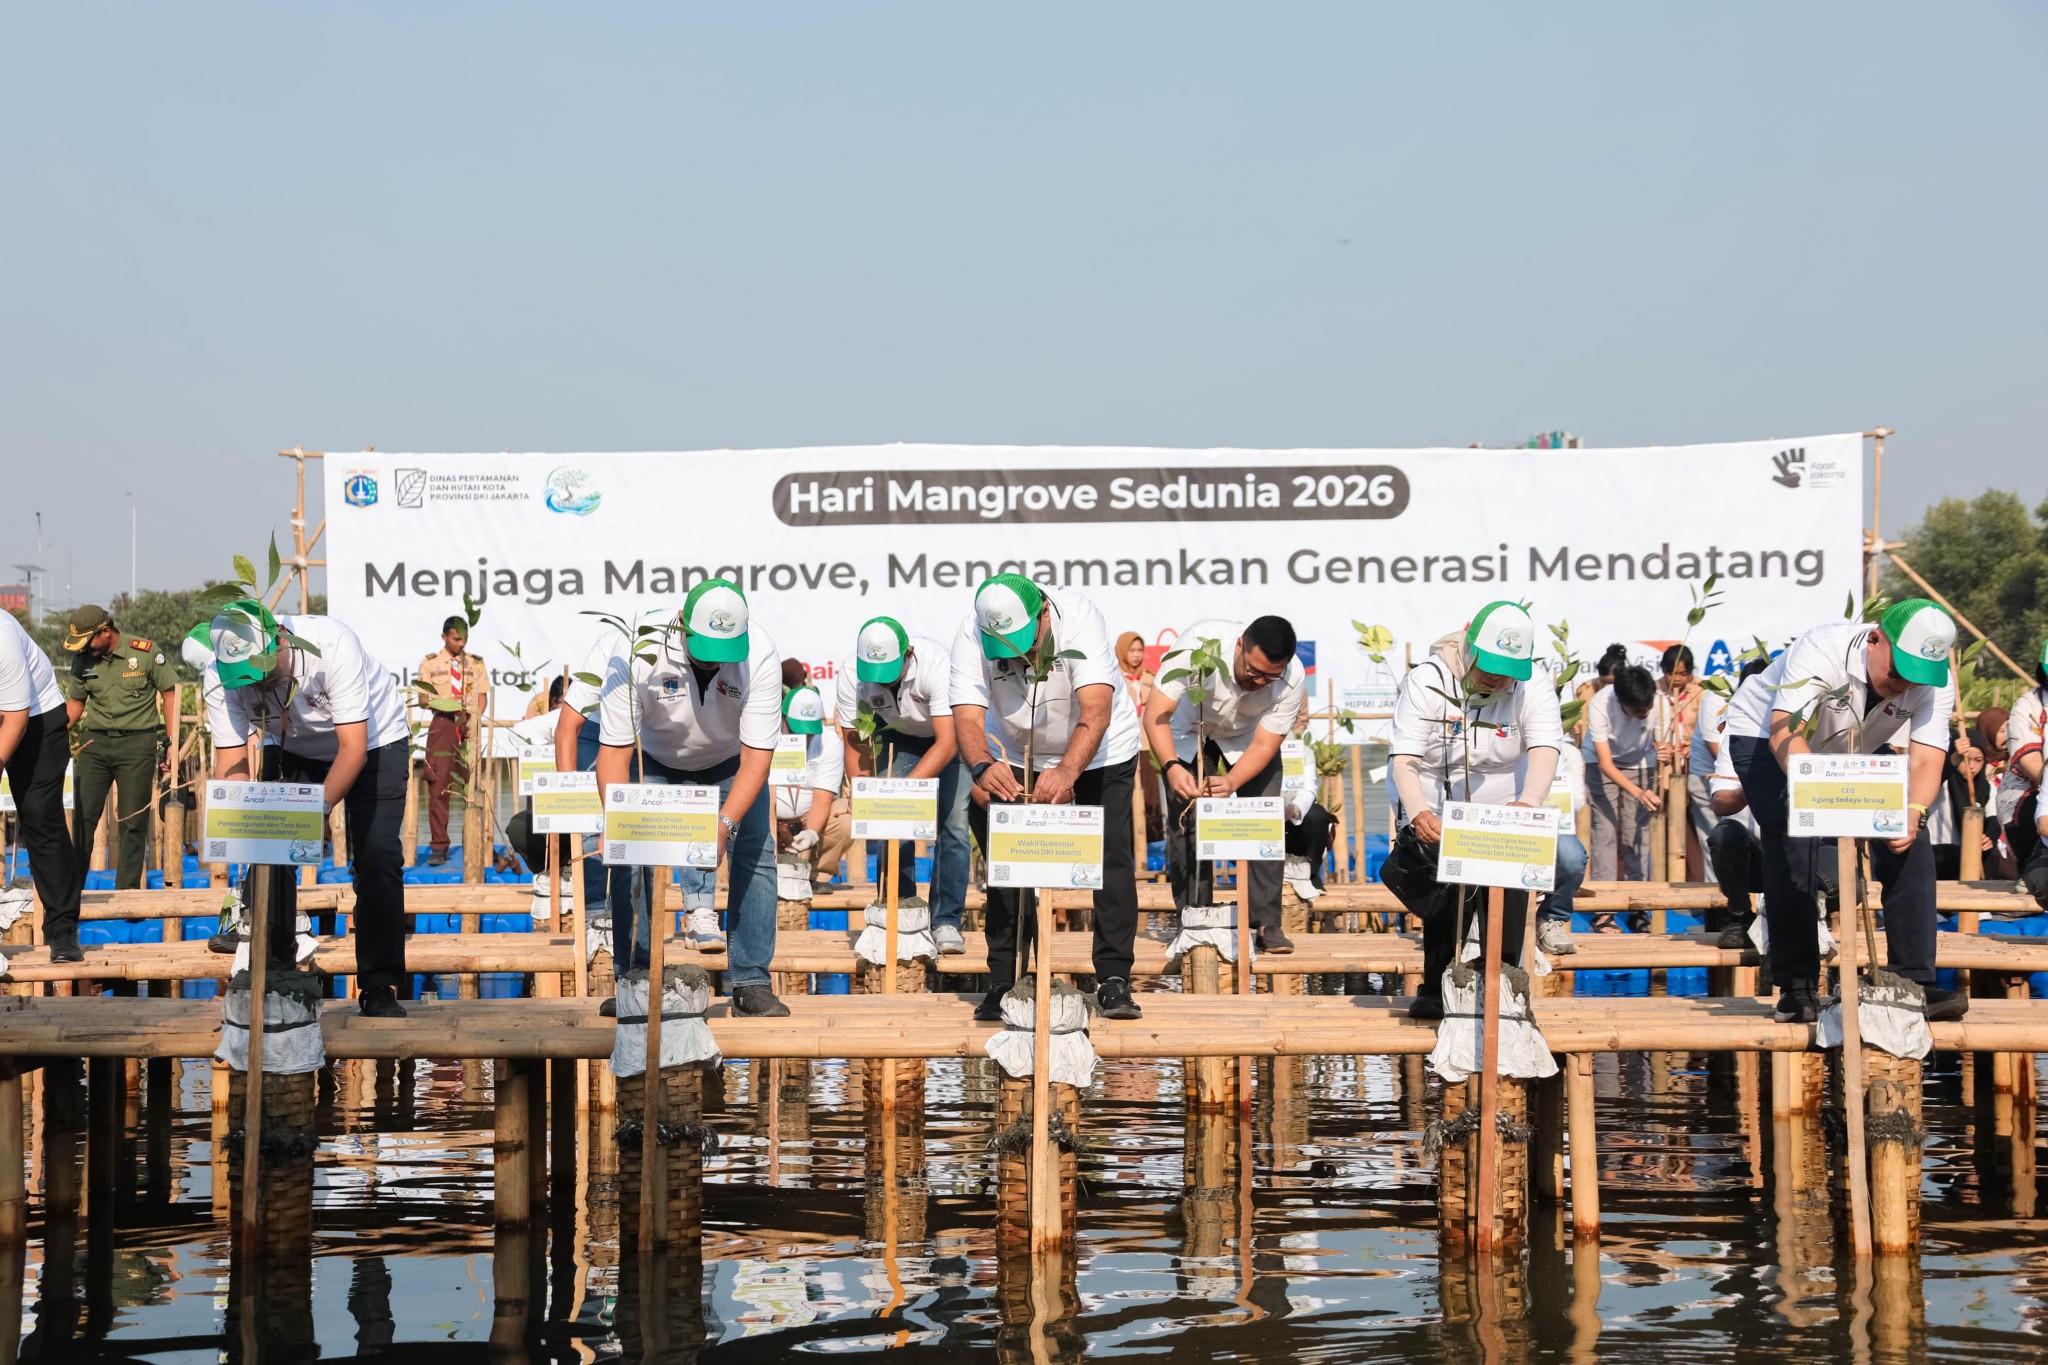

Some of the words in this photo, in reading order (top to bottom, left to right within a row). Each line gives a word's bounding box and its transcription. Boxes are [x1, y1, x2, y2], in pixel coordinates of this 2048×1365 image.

[790, 476, 873, 513] Hari
[888, 480, 1098, 519] Mangrove
[1110, 473, 1280, 509] Sedunia
[1292, 474, 1394, 507] 2026
[365, 557, 583, 605] Menjaga
[604, 560, 869, 596] Mangrove,
[888, 548, 1268, 588] Mengamankan
[1288, 543, 1507, 584] Generasi
[1529, 543, 1824, 587] Mendatang
[1345, 700, 1375, 708] HIPMI
[243, 795, 265, 803] Ancol
[641, 798, 662, 806] Ancol
[1811, 796, 1834, 805] Agung
[1836, 796, 1862, 804] Sedayu
[1863, 797, 1885, 805] Group
[641, 816, 663, 824] Kepala
[664, 816, 682, 824] Dinas
[1026, 819, 1046, 827] Ancol
[1480, 818, 1500, 826] Ancol
[671, 823, 690, 831] Hutan
[1017, 839, 1038, 847] Wakil
[1040, 840, 1074, 848] Gubernur
[1459, 834, 1481, 842] Kepala
[1482, 835, 1500, 843] Dinas
[1501, 837, 1517, 845] Cipta
[1055, 848, 1082, 856] Jakarta
[1505, 845, 1542, 853] Pertanahan
[1467, 848, 1493, 856] Provinsi
[1505, 851, 1529, 859] Jakarta
